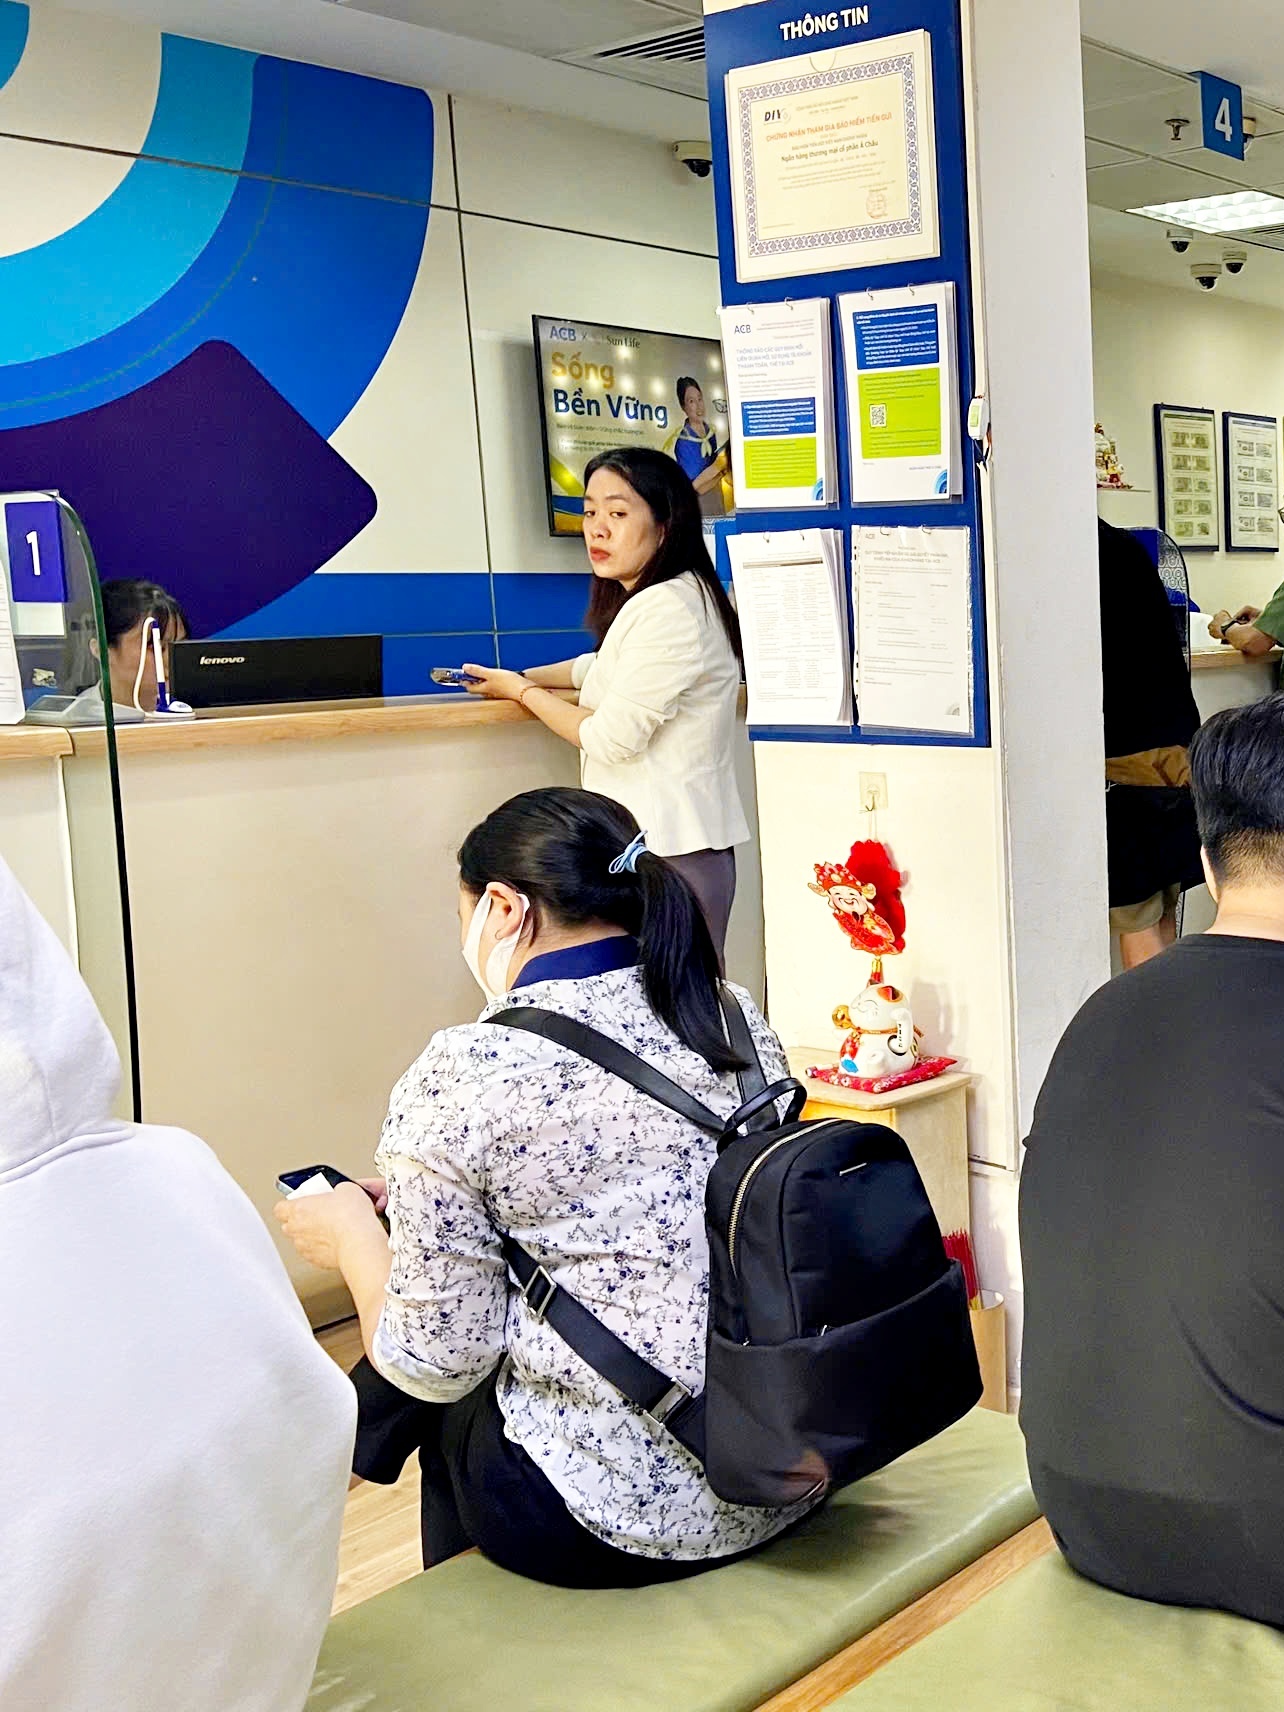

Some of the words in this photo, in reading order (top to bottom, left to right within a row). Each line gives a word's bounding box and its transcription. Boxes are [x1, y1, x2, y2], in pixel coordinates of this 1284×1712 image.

[780, 13, 838, 40] THÔNG
[840, 5, 869, 28] TIN
[1215, 98, 1232, 141] 4
[550, 326, 576, 341] ACB
[734, 324, 751, 334] ACB
[551, 351, 616, 389] Sống
[553, 388, 600, 417] Bền
[606, 394, 668, 428] Vững
[26, 531, 40, 576] 1
[200, 656, 245, 665] lenovo
